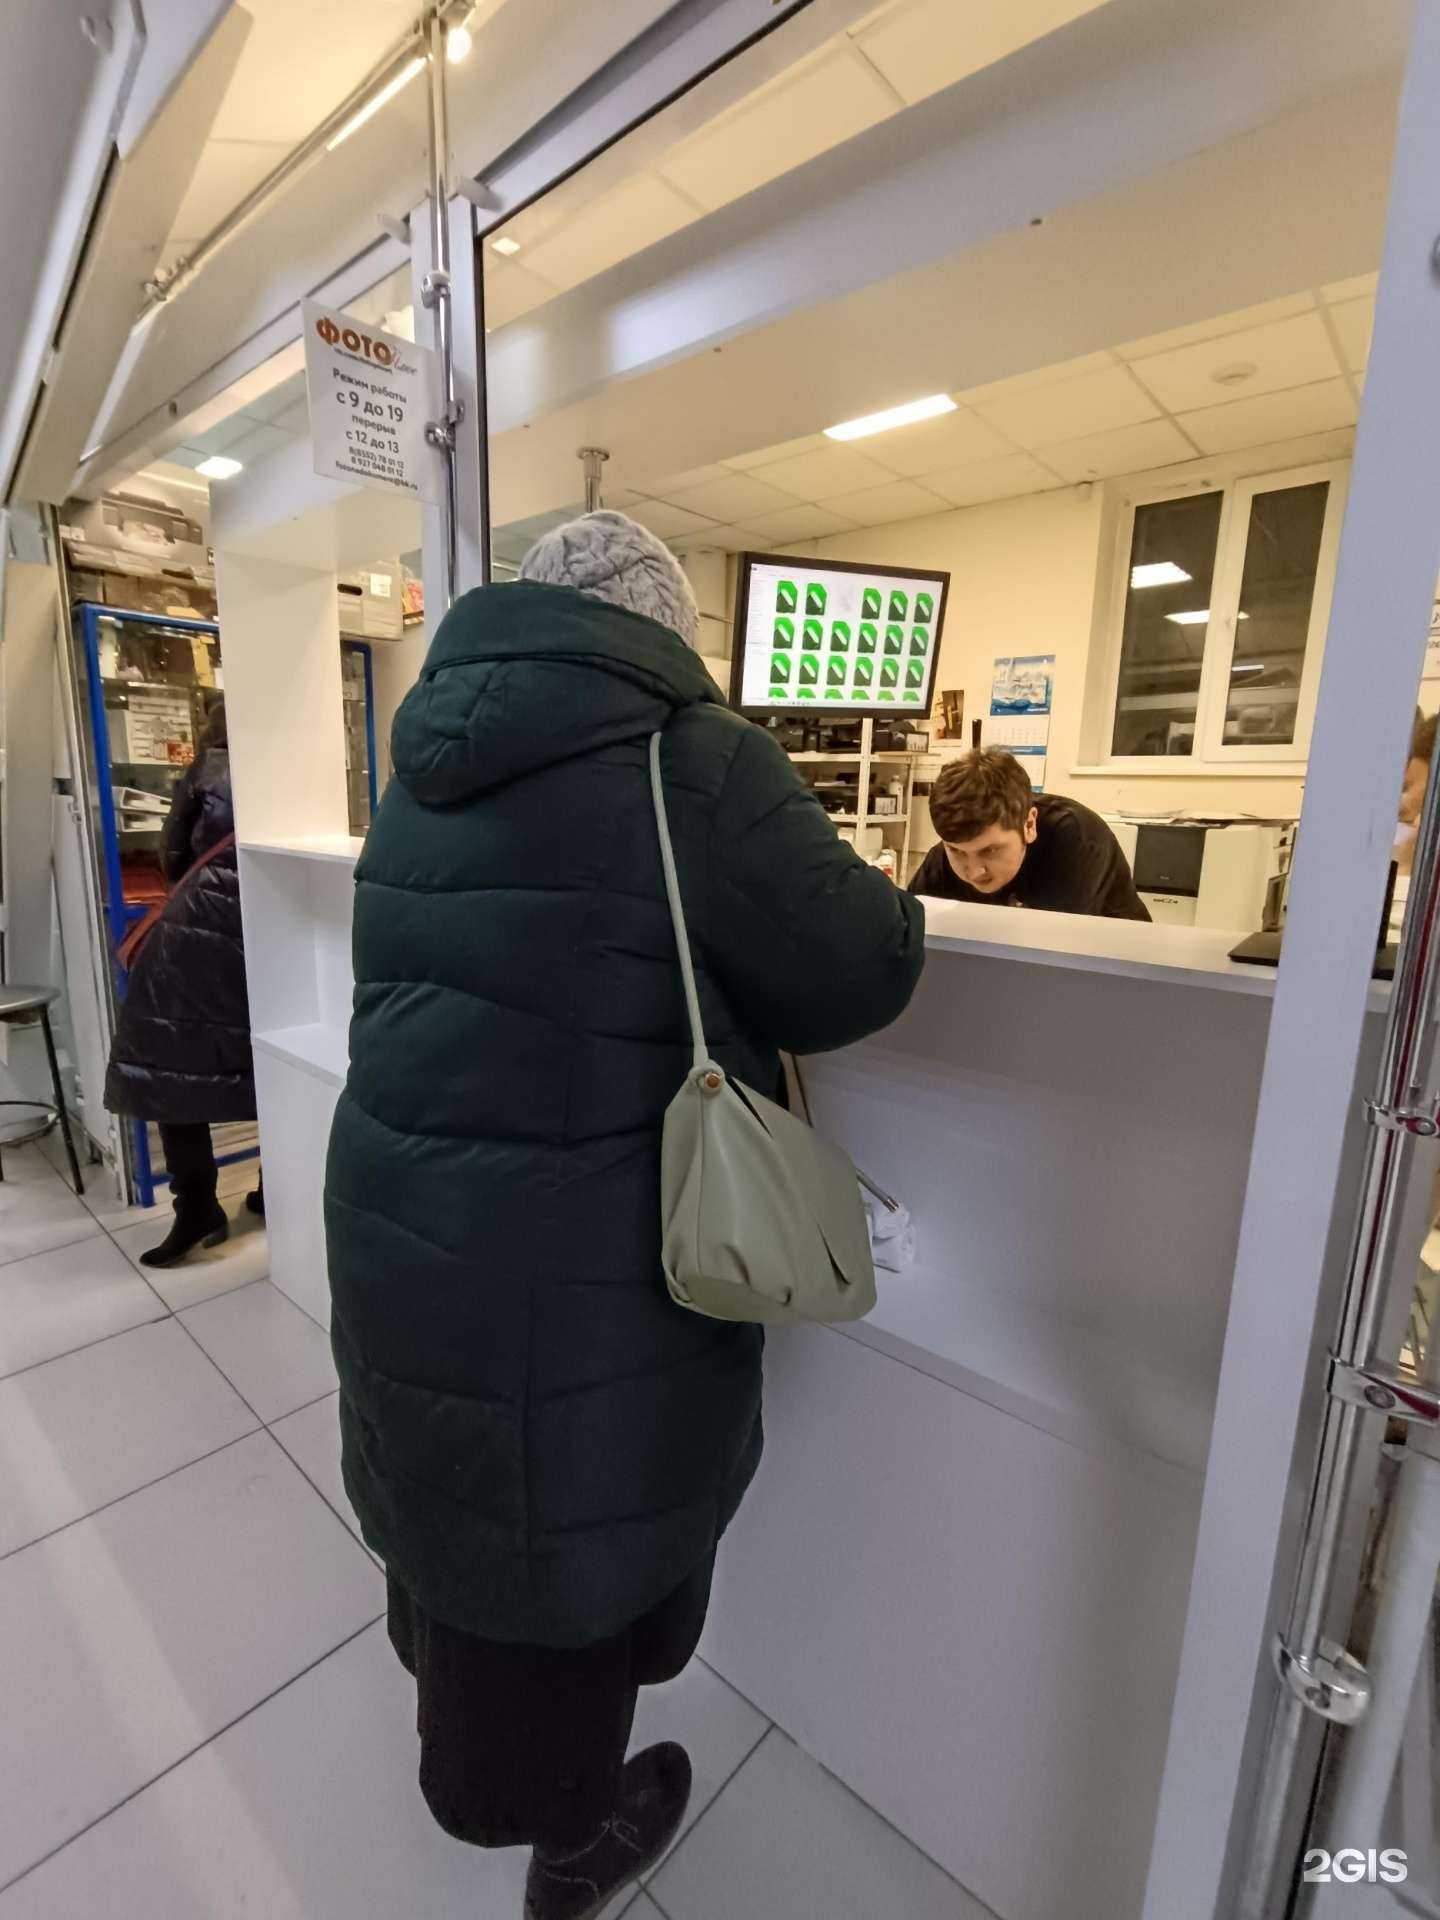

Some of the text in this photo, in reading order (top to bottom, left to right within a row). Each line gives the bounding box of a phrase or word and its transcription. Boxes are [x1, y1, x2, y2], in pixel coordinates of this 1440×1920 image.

[315, 317, 392, 366] ФОТО
[333, 367, 407, 404] Режим работы
[336, 390, 404, 423] с 9 до 19
[351, 414, 397, 436] перерыв
[346, 430, 399, 454] с 12 до 13
